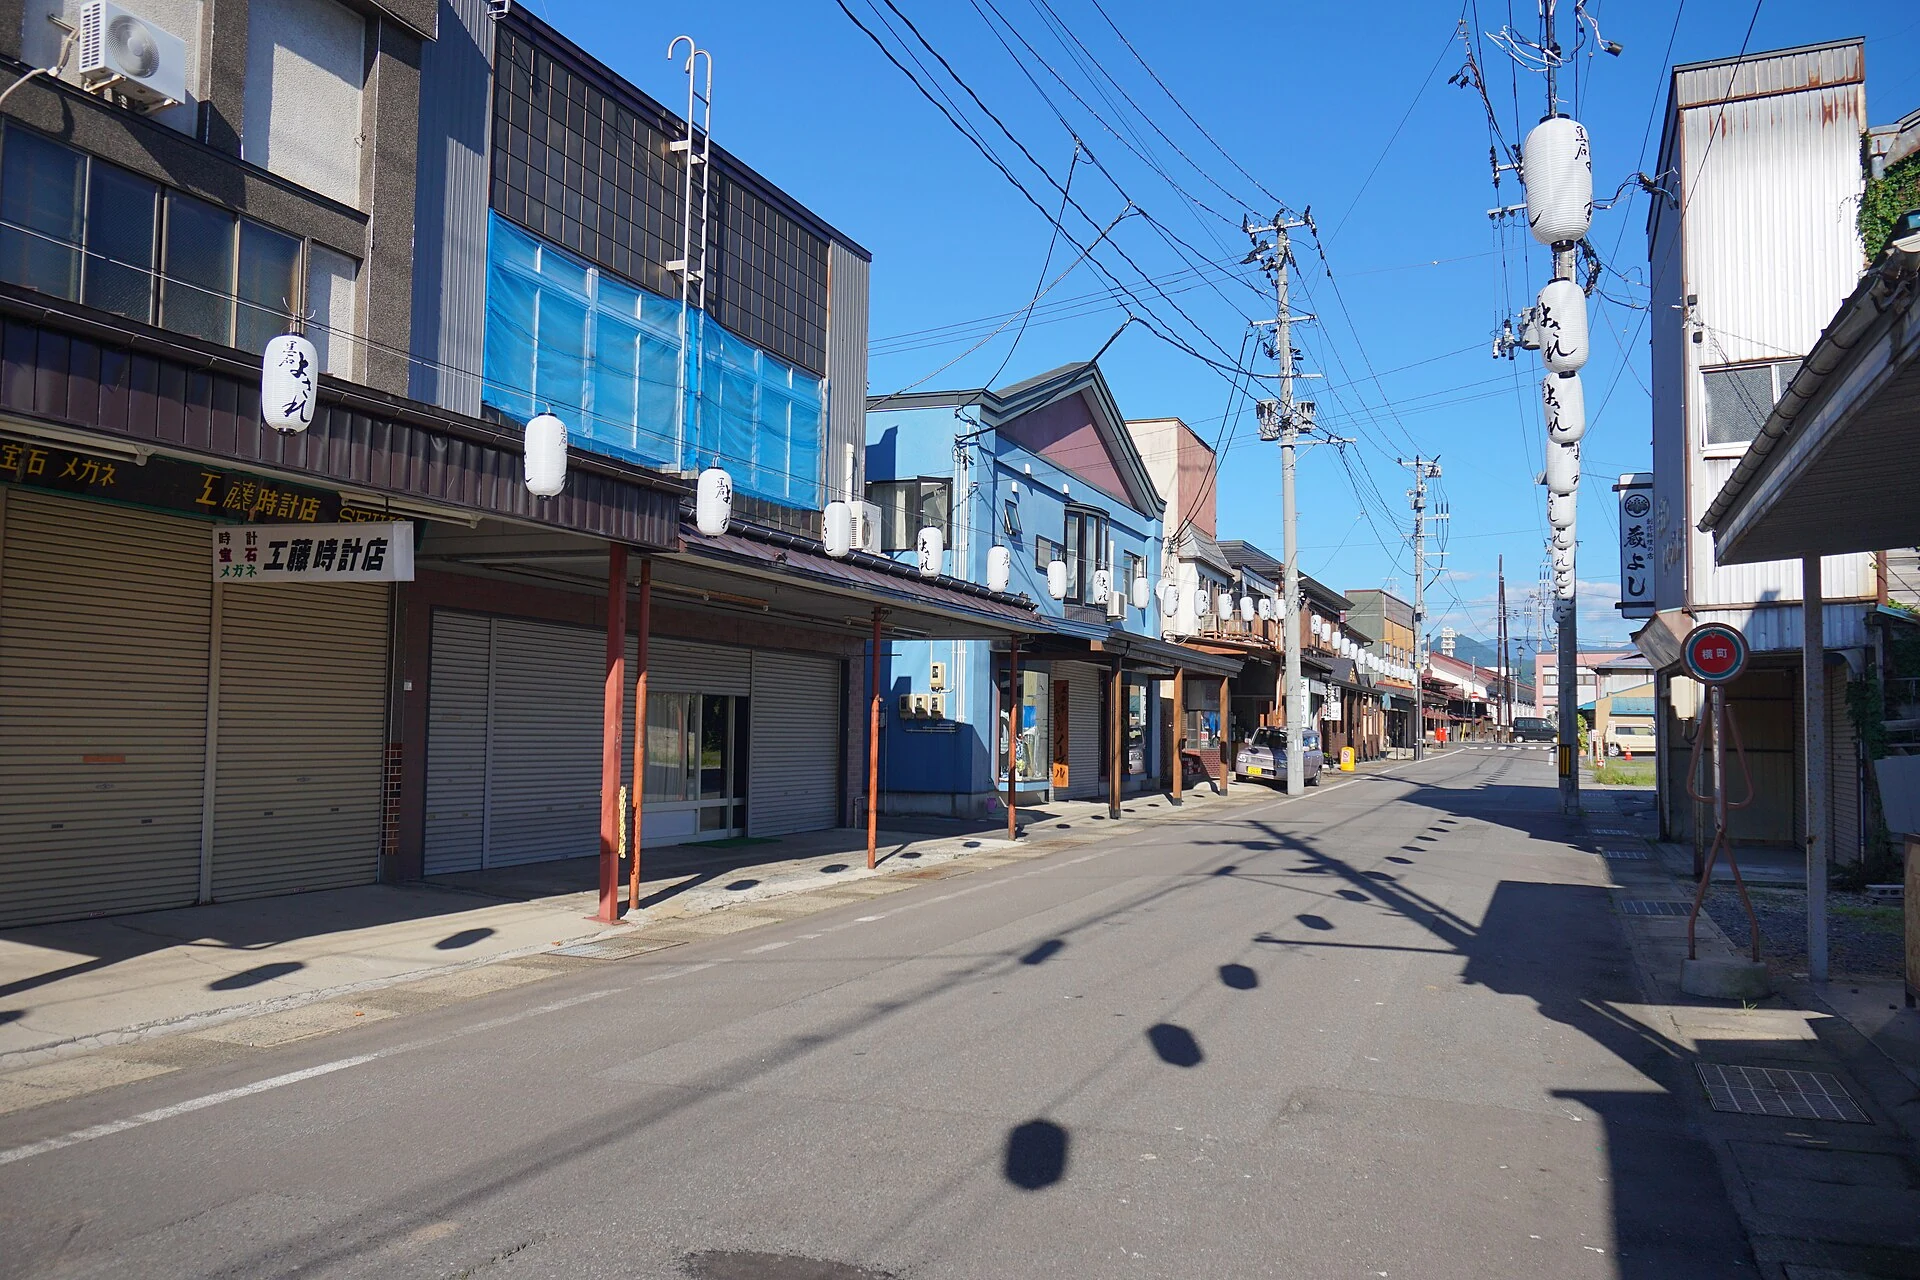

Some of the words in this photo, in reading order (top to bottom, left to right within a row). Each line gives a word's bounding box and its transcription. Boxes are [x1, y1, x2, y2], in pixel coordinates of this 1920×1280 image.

[0, 444, 49, 476] 宝石
[58, 457, 116, 487] メガネ
[195, 472, 322, 523] 工藤時計店
[218, 531, 258, 546] 時計
[218, 547, 258, 563] 宝石
[263, 537, 389, 572] 工藤時計店
[220, 564, 257, 578] メガネ
[1702, 648, 1727, 660] 横町
